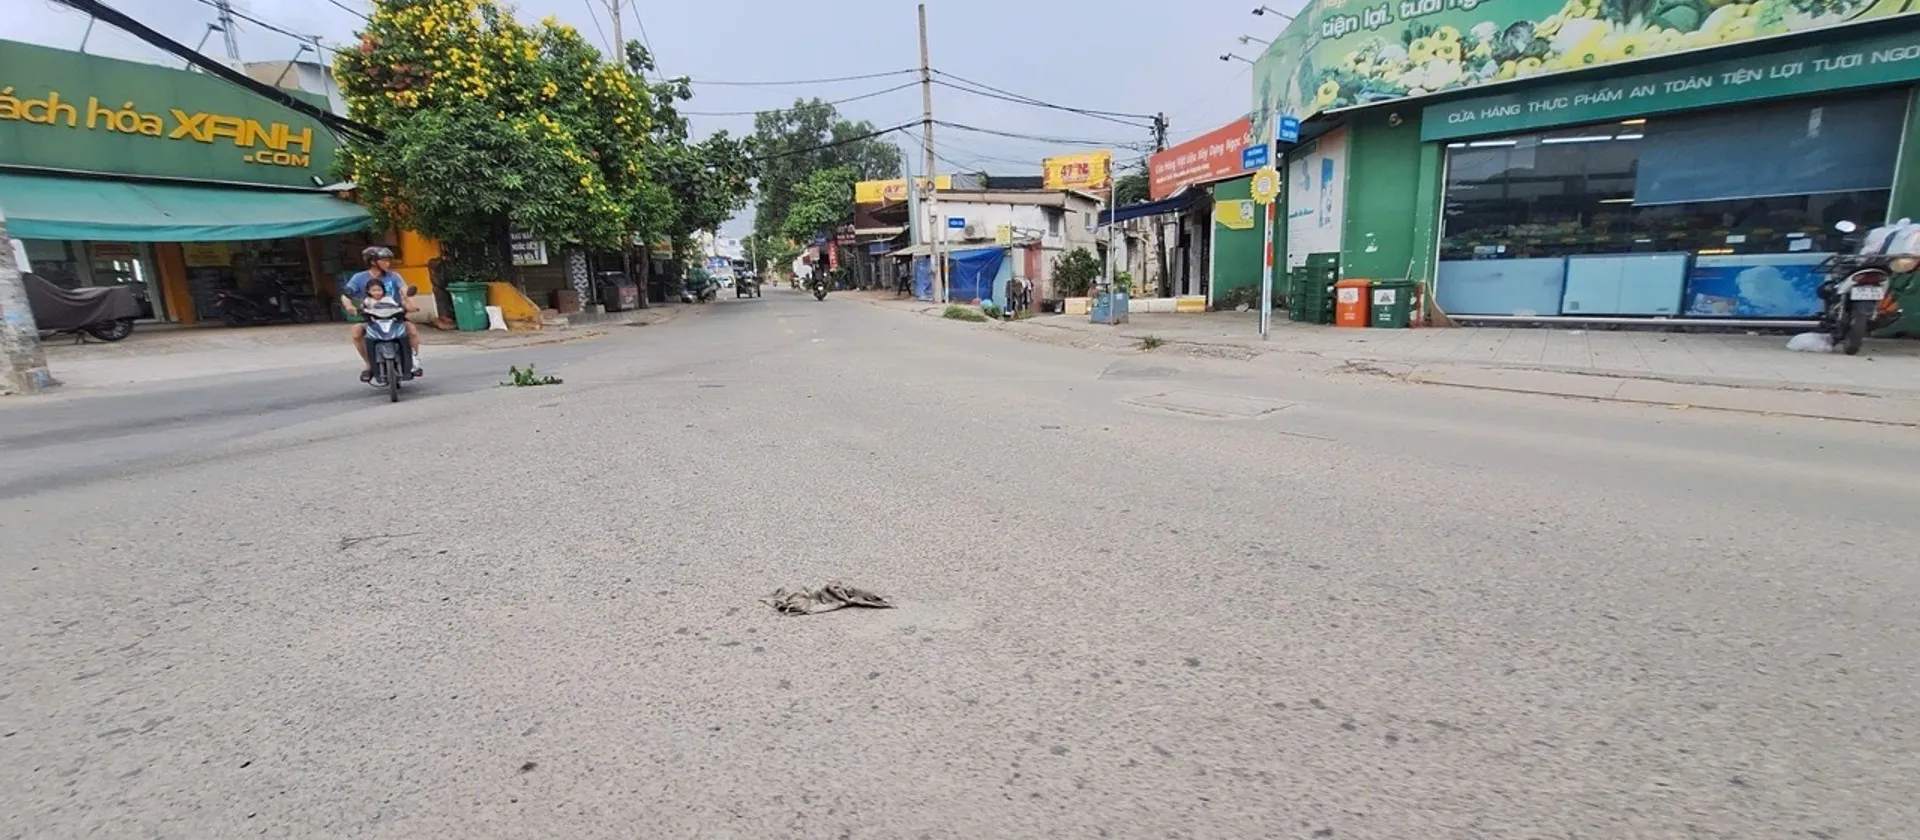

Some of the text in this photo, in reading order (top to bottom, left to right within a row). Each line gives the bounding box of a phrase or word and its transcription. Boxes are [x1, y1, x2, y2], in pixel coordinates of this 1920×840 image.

[1322, 16, 1358, 38] tiện
[1448, 109, 1476, 124] CỬA
[1481, 104, 1521, 119] HÀNG
[1527, 97, 1569, 113] THỰC
[1629, 83, 1656, 99] AN
[1664, 75, 1713, 93] TOÀN
[1721, 68, 1763, 85] TIỆN
[1770, 61, 1804, 79] LỢI
[1812, 53, 1864, 72] TƯƠI
[86, 96, 163, 137] hóa
[168, 109, 312, 153] XANH
